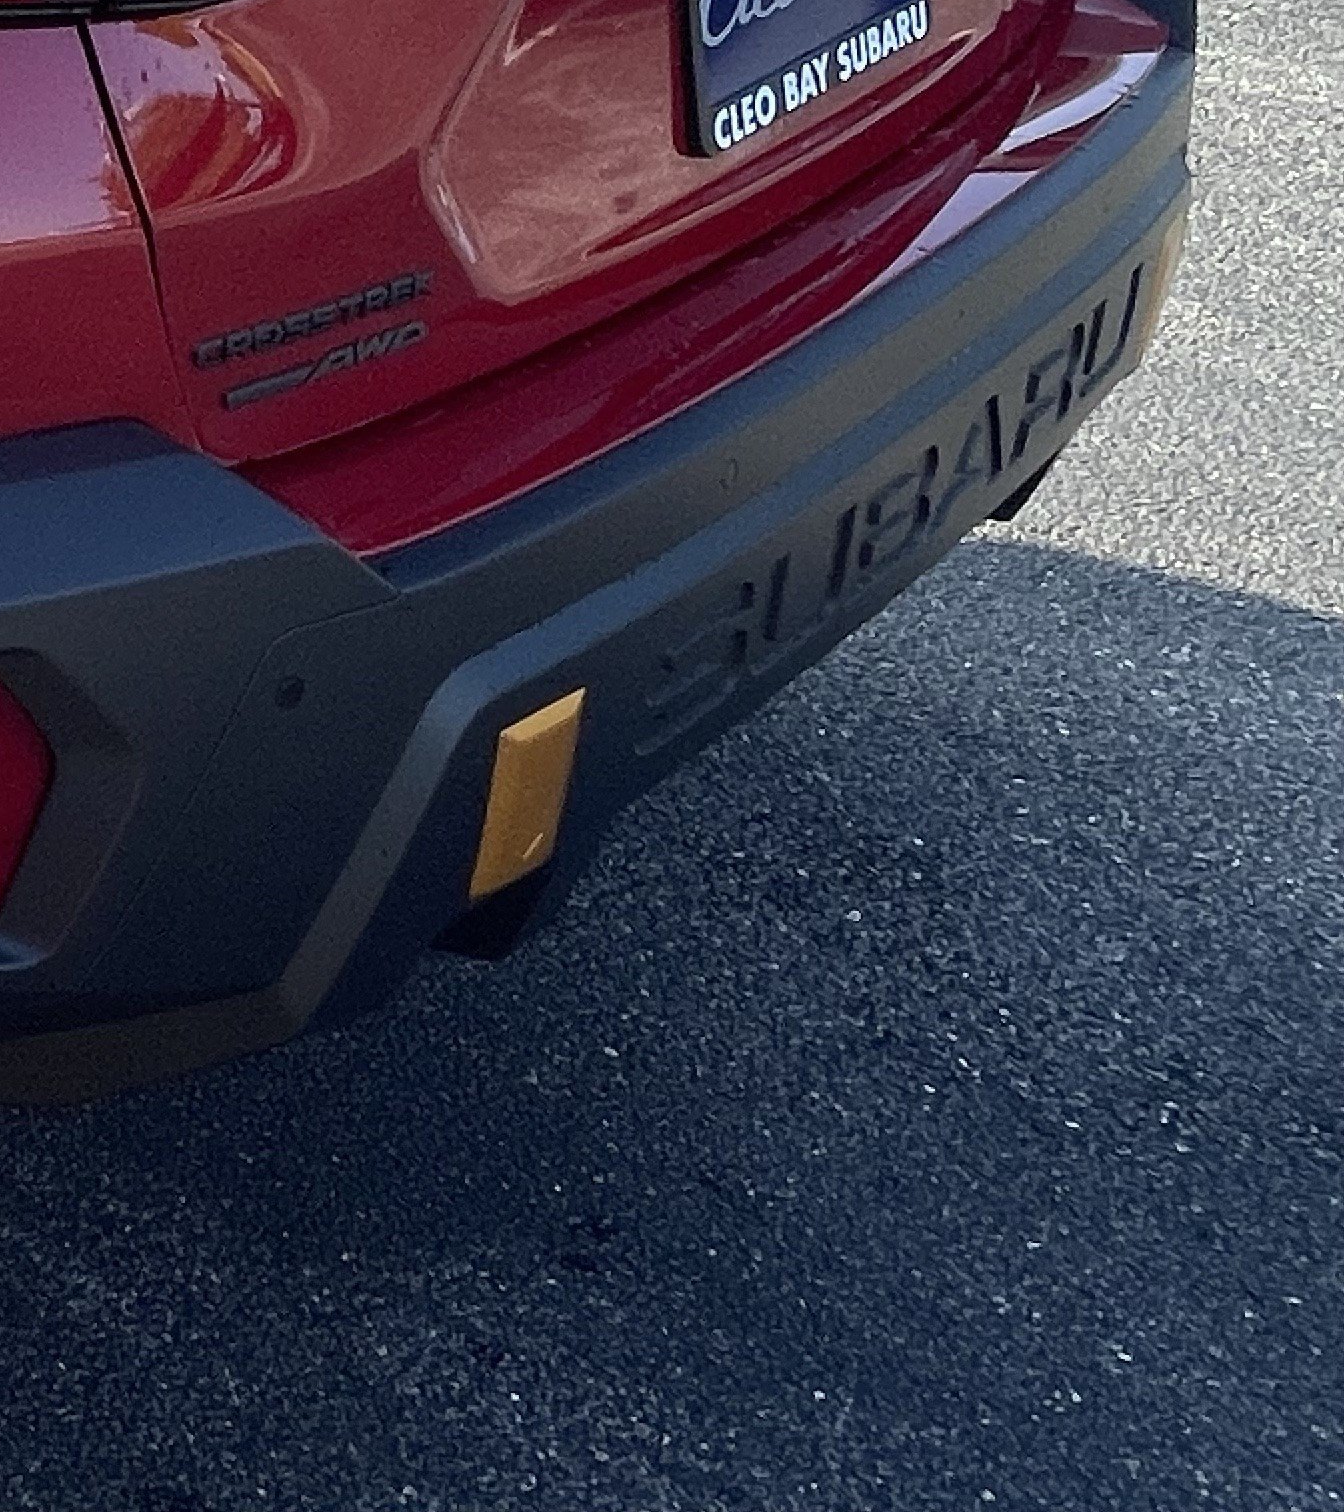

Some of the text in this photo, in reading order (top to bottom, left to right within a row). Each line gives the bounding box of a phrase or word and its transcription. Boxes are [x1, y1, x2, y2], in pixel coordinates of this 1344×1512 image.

[713, 0, 929, 150] CLEO BAY SUBARU
[192, 266, 436, 371] CROSSTREK
[310, 318, 430, 381] AWD
[632, 261, 1145, 758] SUBARU
